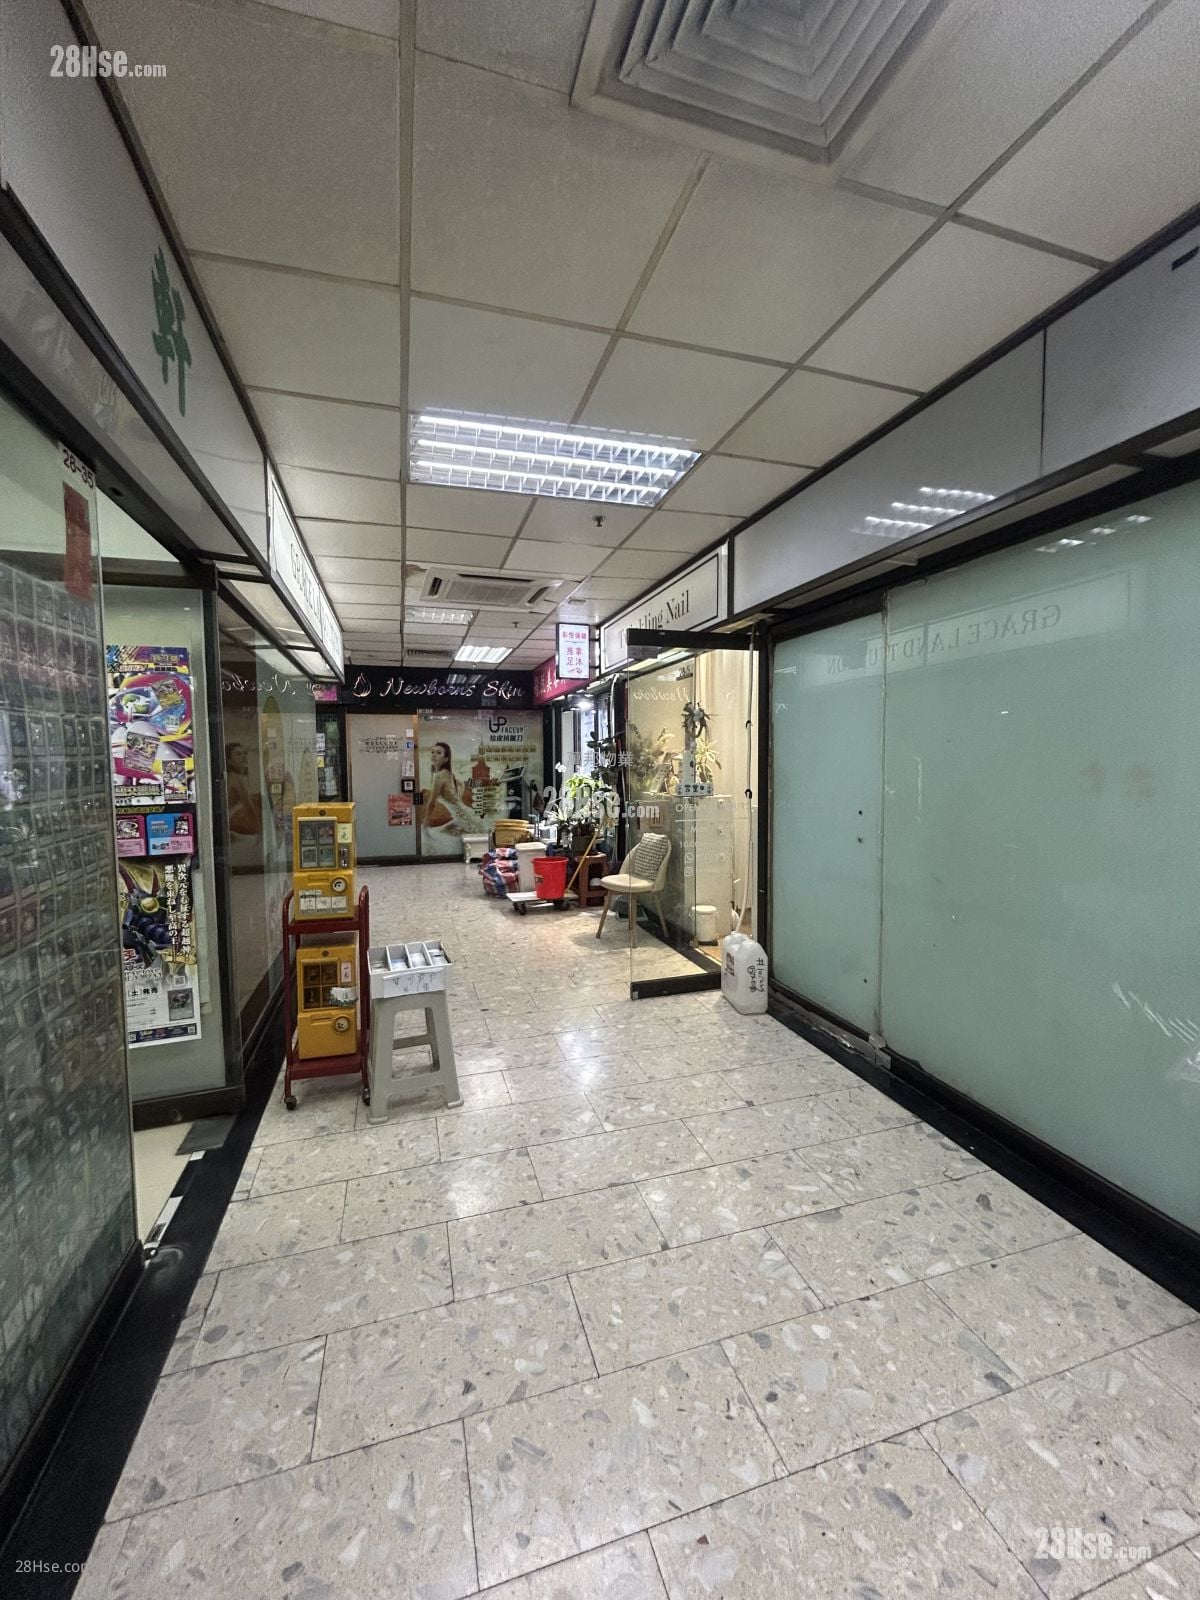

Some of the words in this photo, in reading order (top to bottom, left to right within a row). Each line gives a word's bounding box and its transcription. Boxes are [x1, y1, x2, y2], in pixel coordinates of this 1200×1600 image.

[63, 449, 95, 489] 28-35
[666, 589, 690, 624] Nail
[483, 680, 526, 700] Skin
